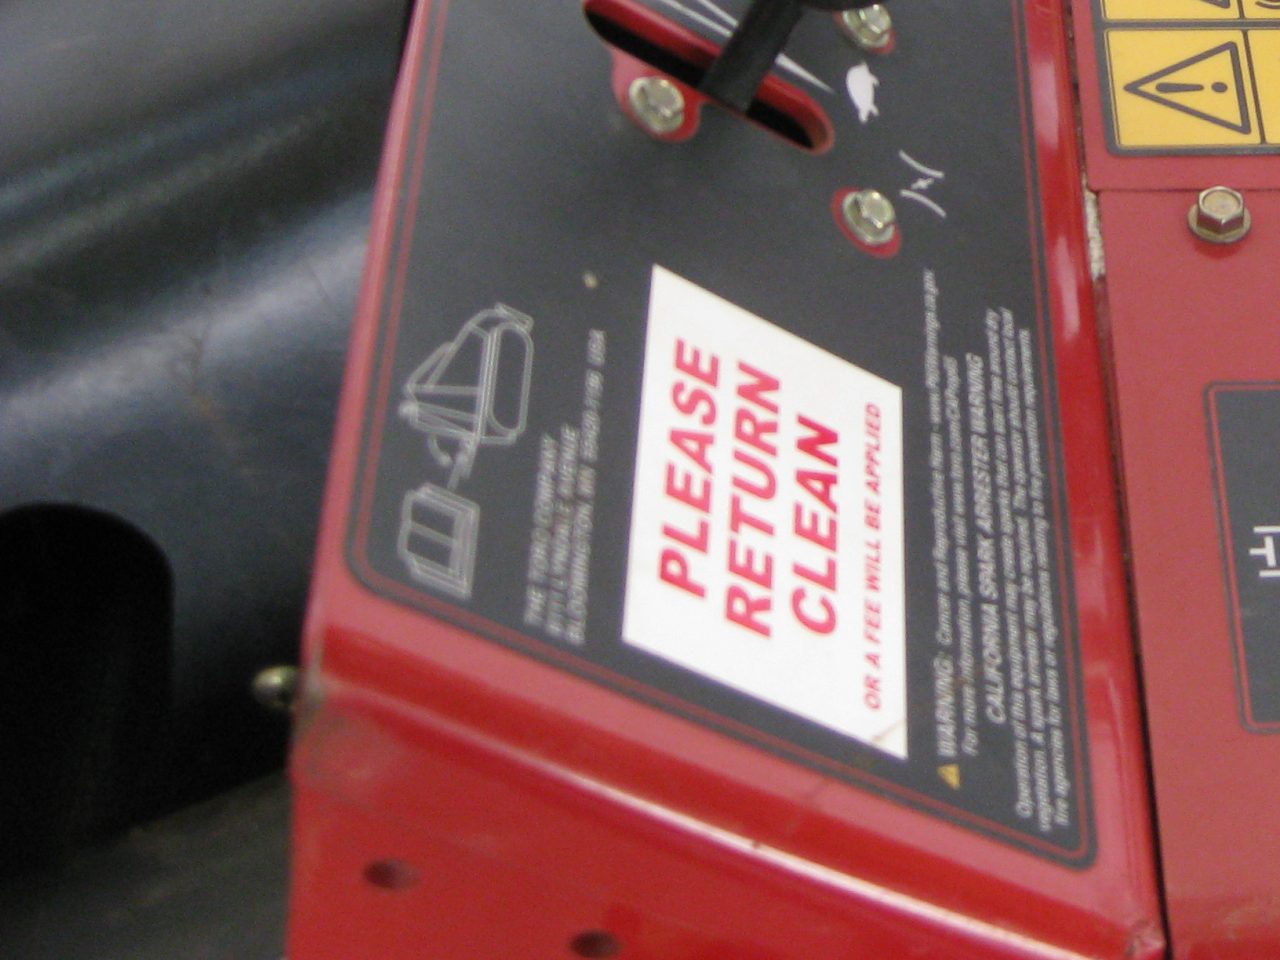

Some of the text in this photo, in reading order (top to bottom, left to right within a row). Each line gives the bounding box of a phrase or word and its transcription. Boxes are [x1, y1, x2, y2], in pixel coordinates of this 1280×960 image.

[659, 337, 720, 599] PLEASE
[724, 360, 781, 638] RETURN
[790, 414, 839, 636] CLEAN
[865, 402, 881, 710] OR A FEE WILL BE APPLIED
[965, 353, 1006, 724] CALIFORNIA SPARK ARRESTER WARNING
